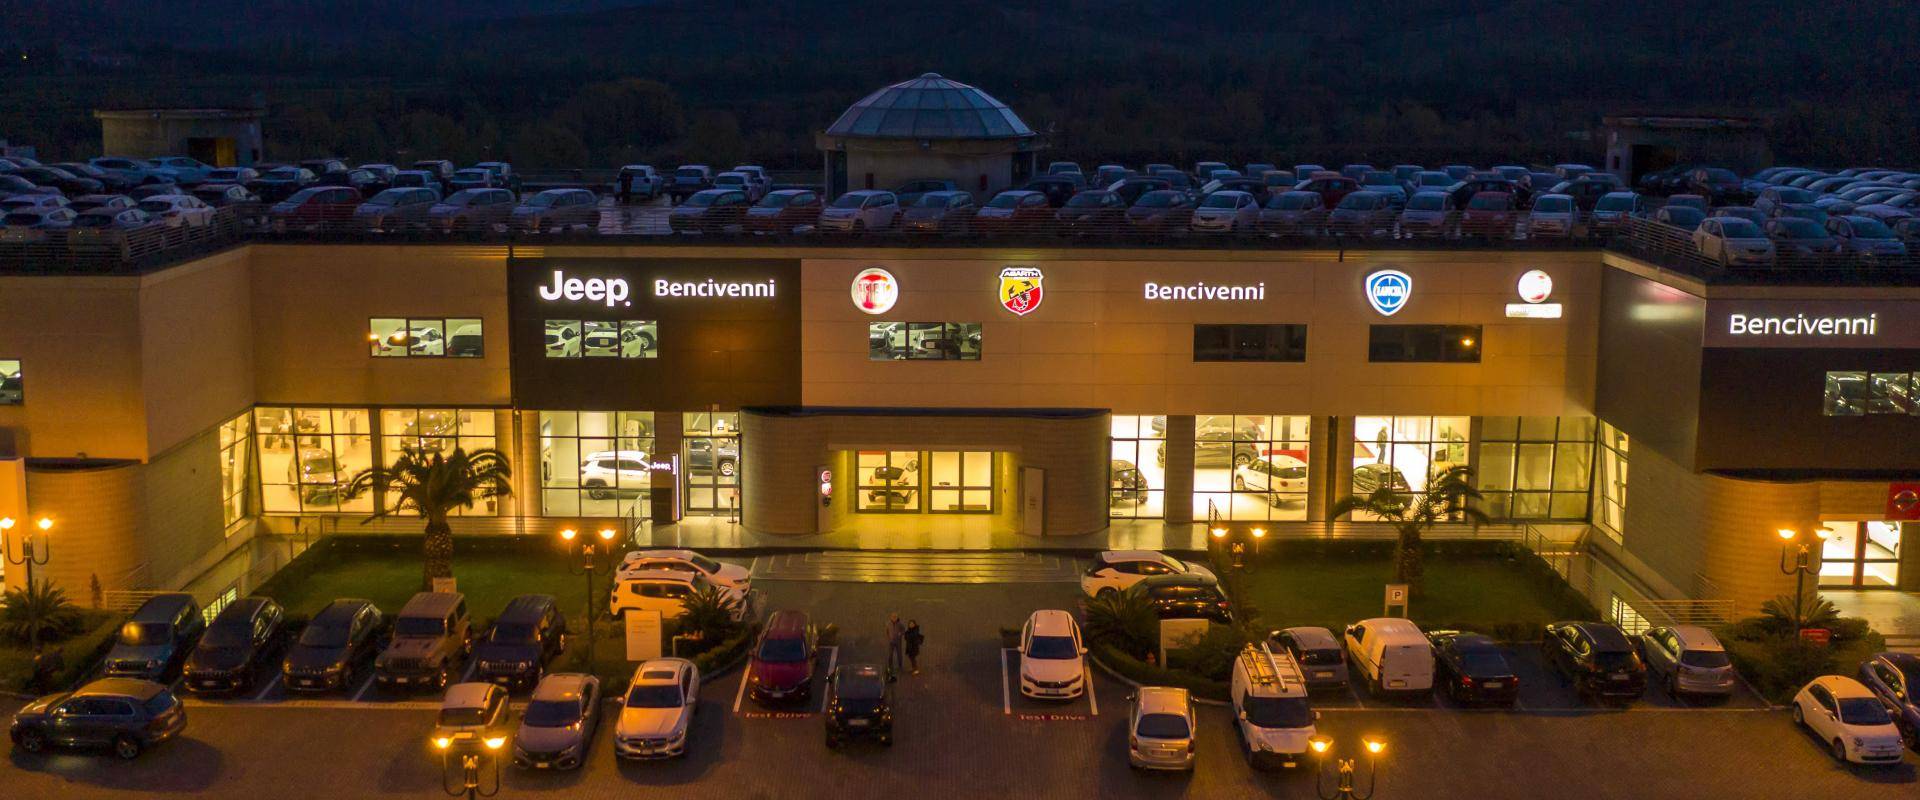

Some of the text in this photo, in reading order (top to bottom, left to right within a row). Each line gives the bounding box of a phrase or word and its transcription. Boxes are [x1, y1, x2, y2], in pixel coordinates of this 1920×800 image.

[654, 278, 776, 298] Bencivenni
[1144, 281, 1265, 300] Bencivenni
[1729, 312, 1877, 335] Bencivenni
